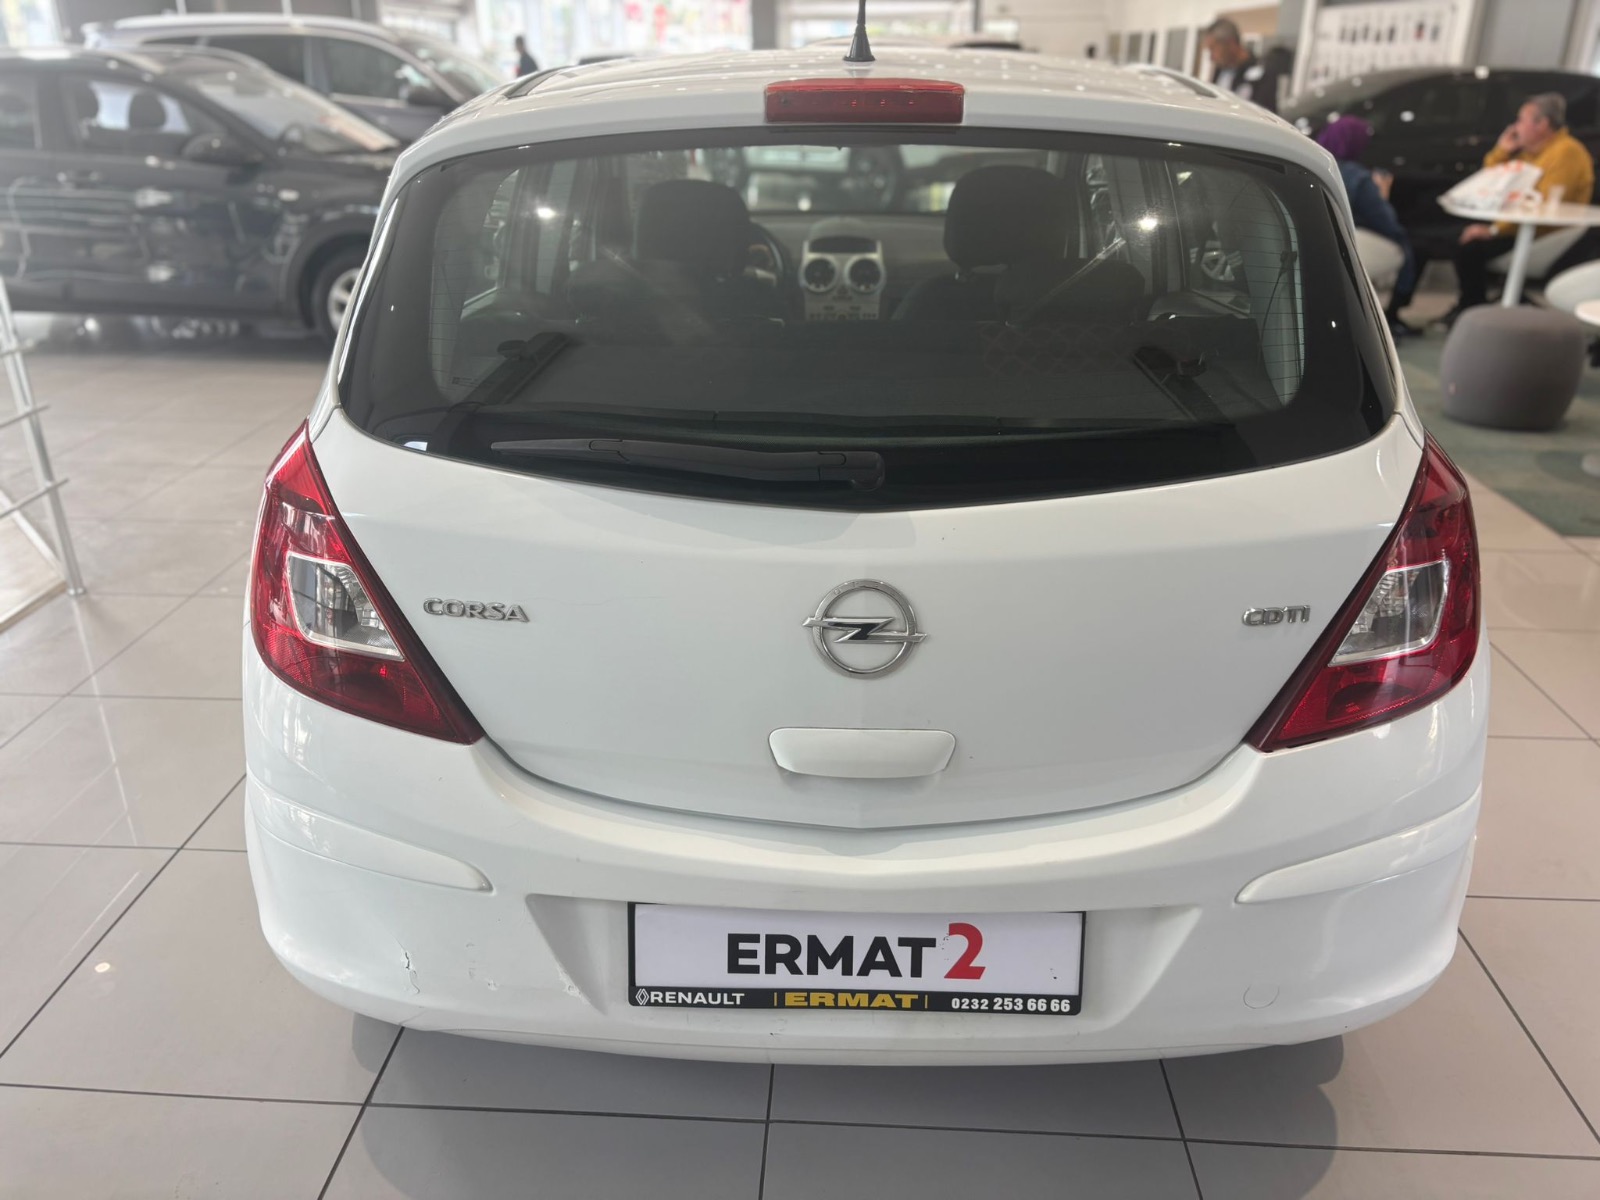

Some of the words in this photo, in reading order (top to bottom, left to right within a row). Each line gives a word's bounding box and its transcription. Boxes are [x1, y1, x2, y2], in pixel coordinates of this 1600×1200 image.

[423, 597, 530, 622] CORSA
[1242, 605, 1310, 626] CDTI
[727, 933, 936, 978] ERMAT
[943, 922, 986, 980] 2
[650, 991, 745, 1006] RENAULT
[785, 992, 919, 1009] ERMAT
[951, 997, 989, 1010] 0232
[993, 997, 1024, 1011] 253
[1026, 998, 1047, 1012] 66
[1050, 999, 1071, 1013] 66
